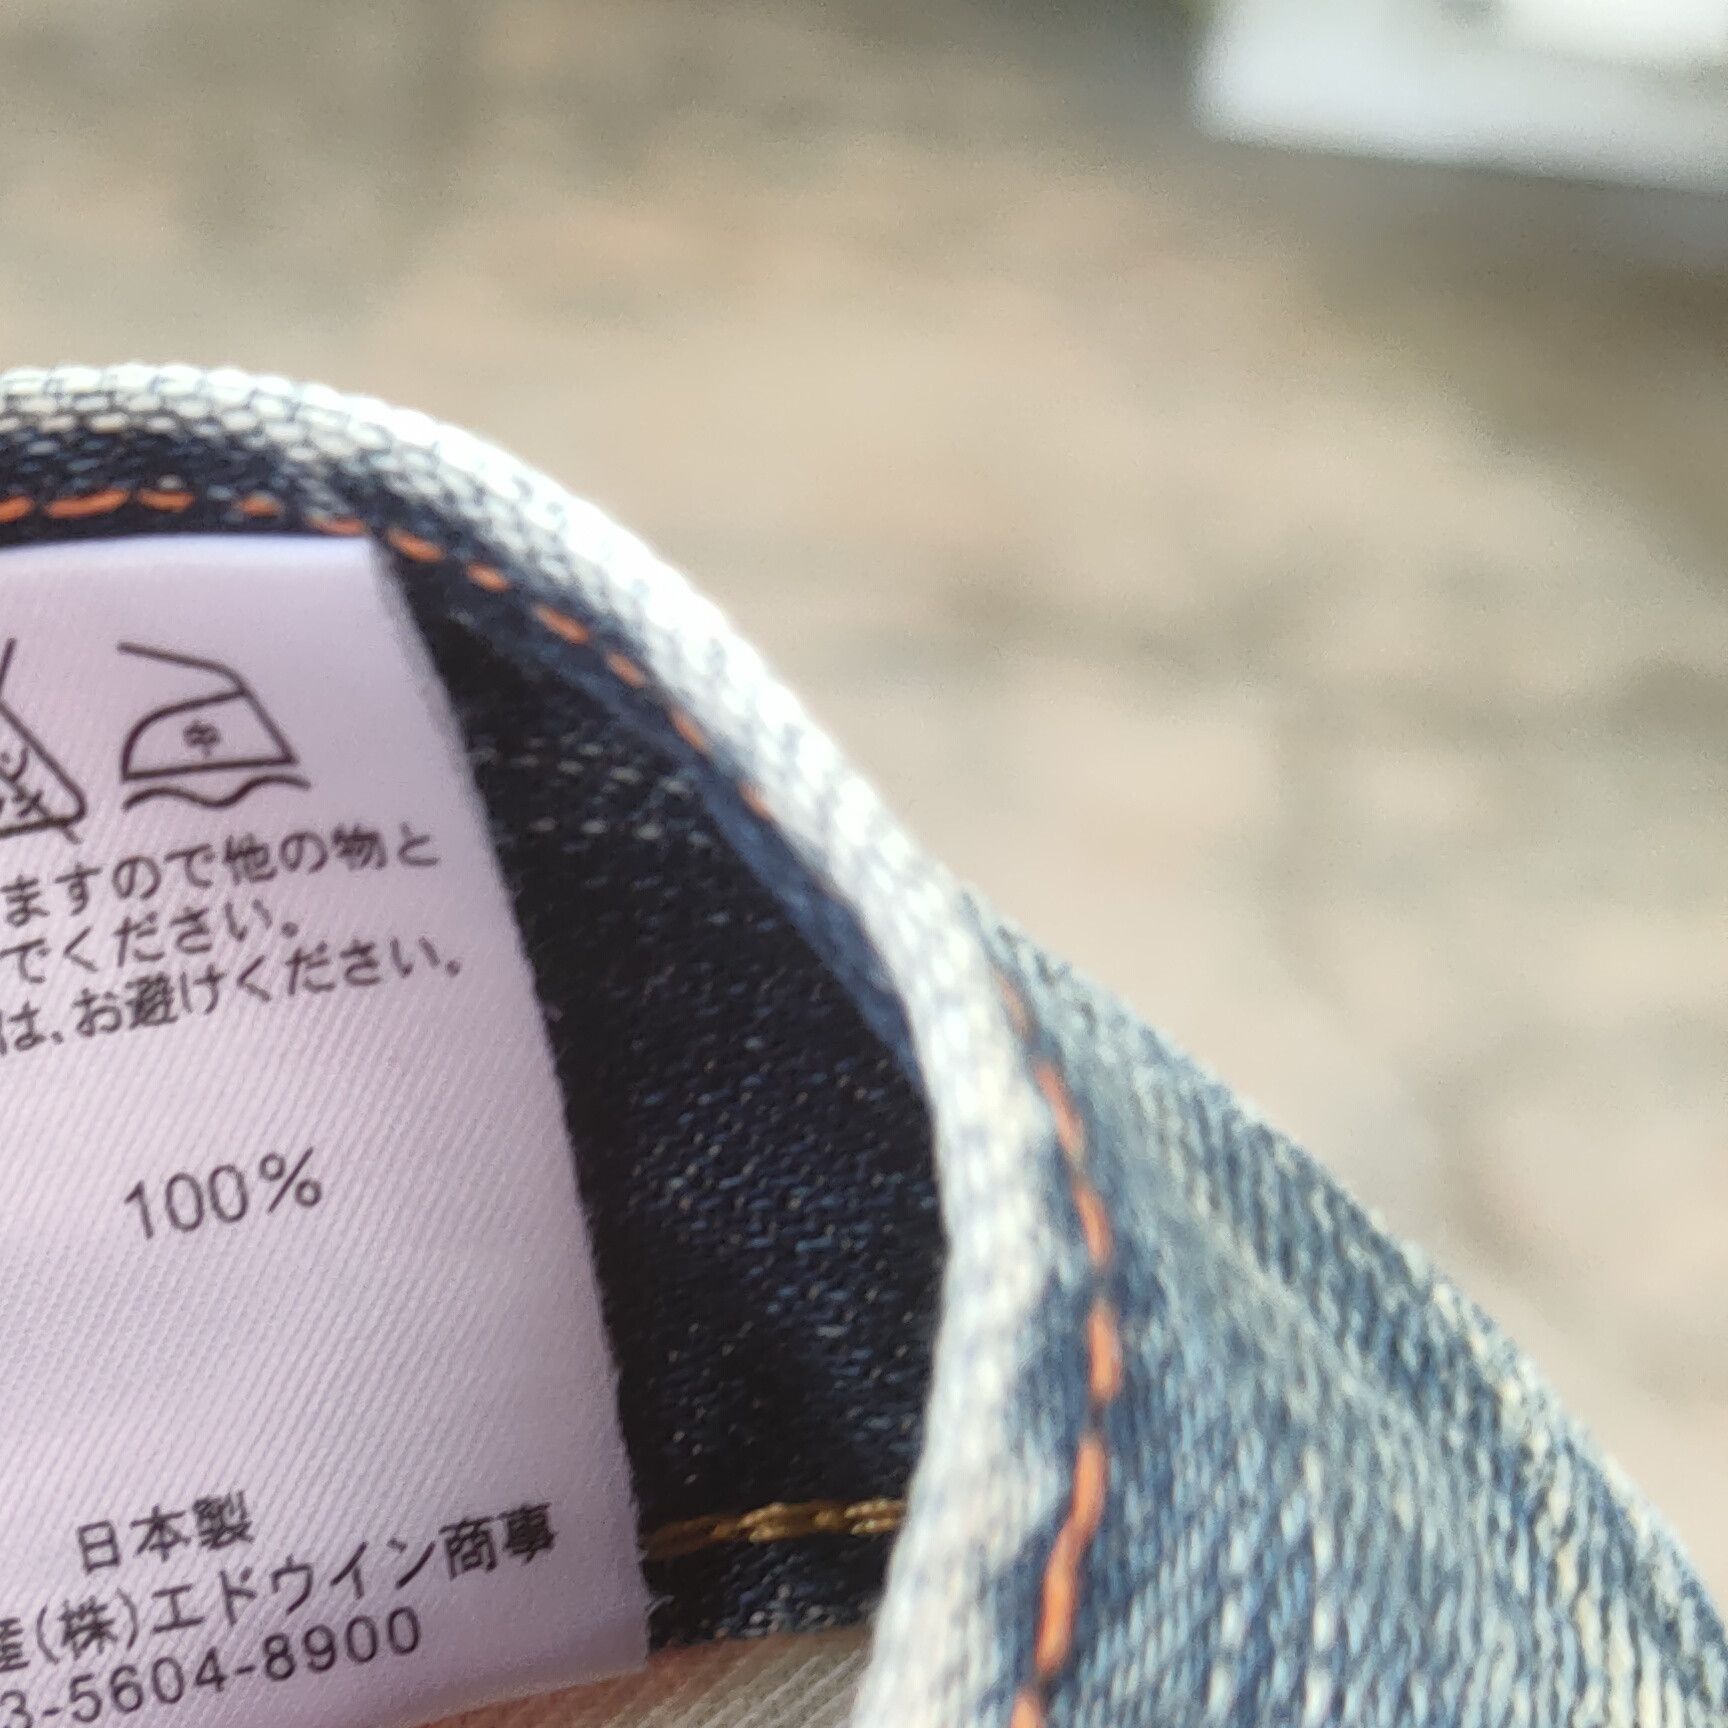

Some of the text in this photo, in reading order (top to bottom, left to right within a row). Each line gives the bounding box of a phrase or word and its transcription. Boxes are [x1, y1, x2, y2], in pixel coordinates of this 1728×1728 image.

[122, 1147, 324, 1242] 100%
[76, 1489, 255, 1574] 日本製
